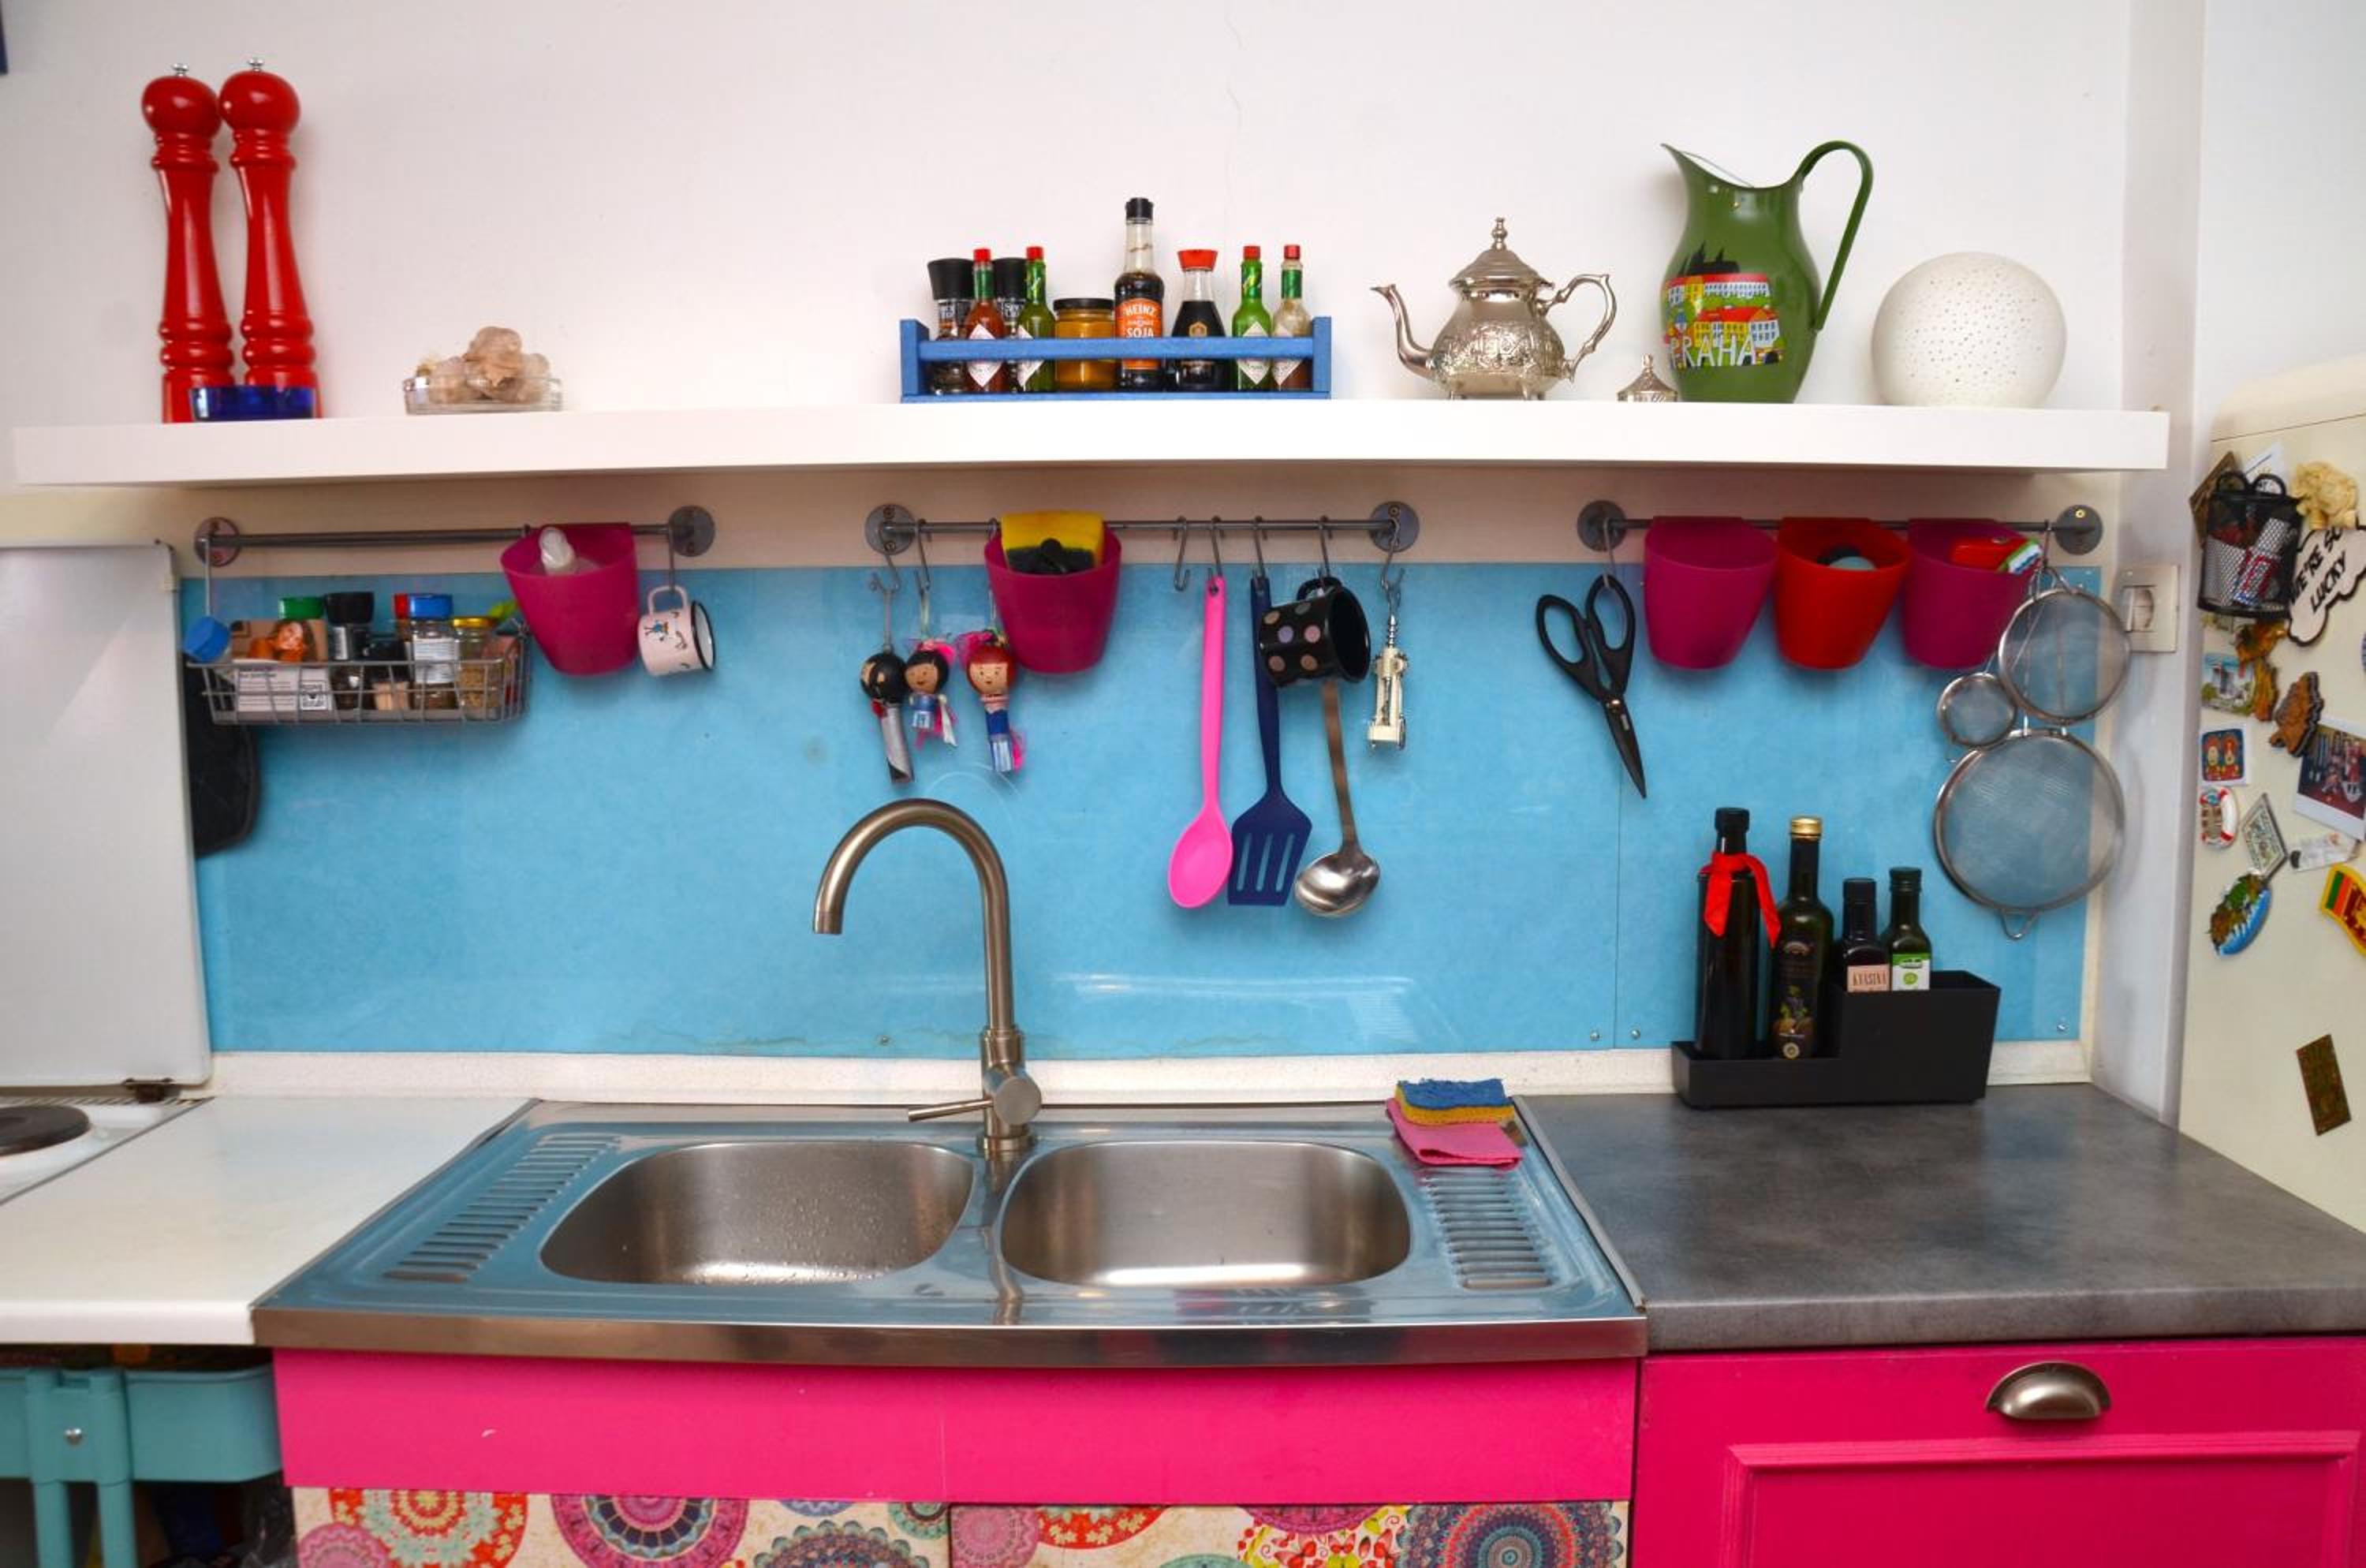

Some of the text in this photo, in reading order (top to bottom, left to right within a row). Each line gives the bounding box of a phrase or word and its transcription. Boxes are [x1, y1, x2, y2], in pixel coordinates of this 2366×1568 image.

[1124, 303, 1155, 316] HEINZ
[1126, 327, 1154, 338] SOJA
[1669, 333, 1756, 368] PRAHA
[2310, 550, 2346, 614] LUCKY
